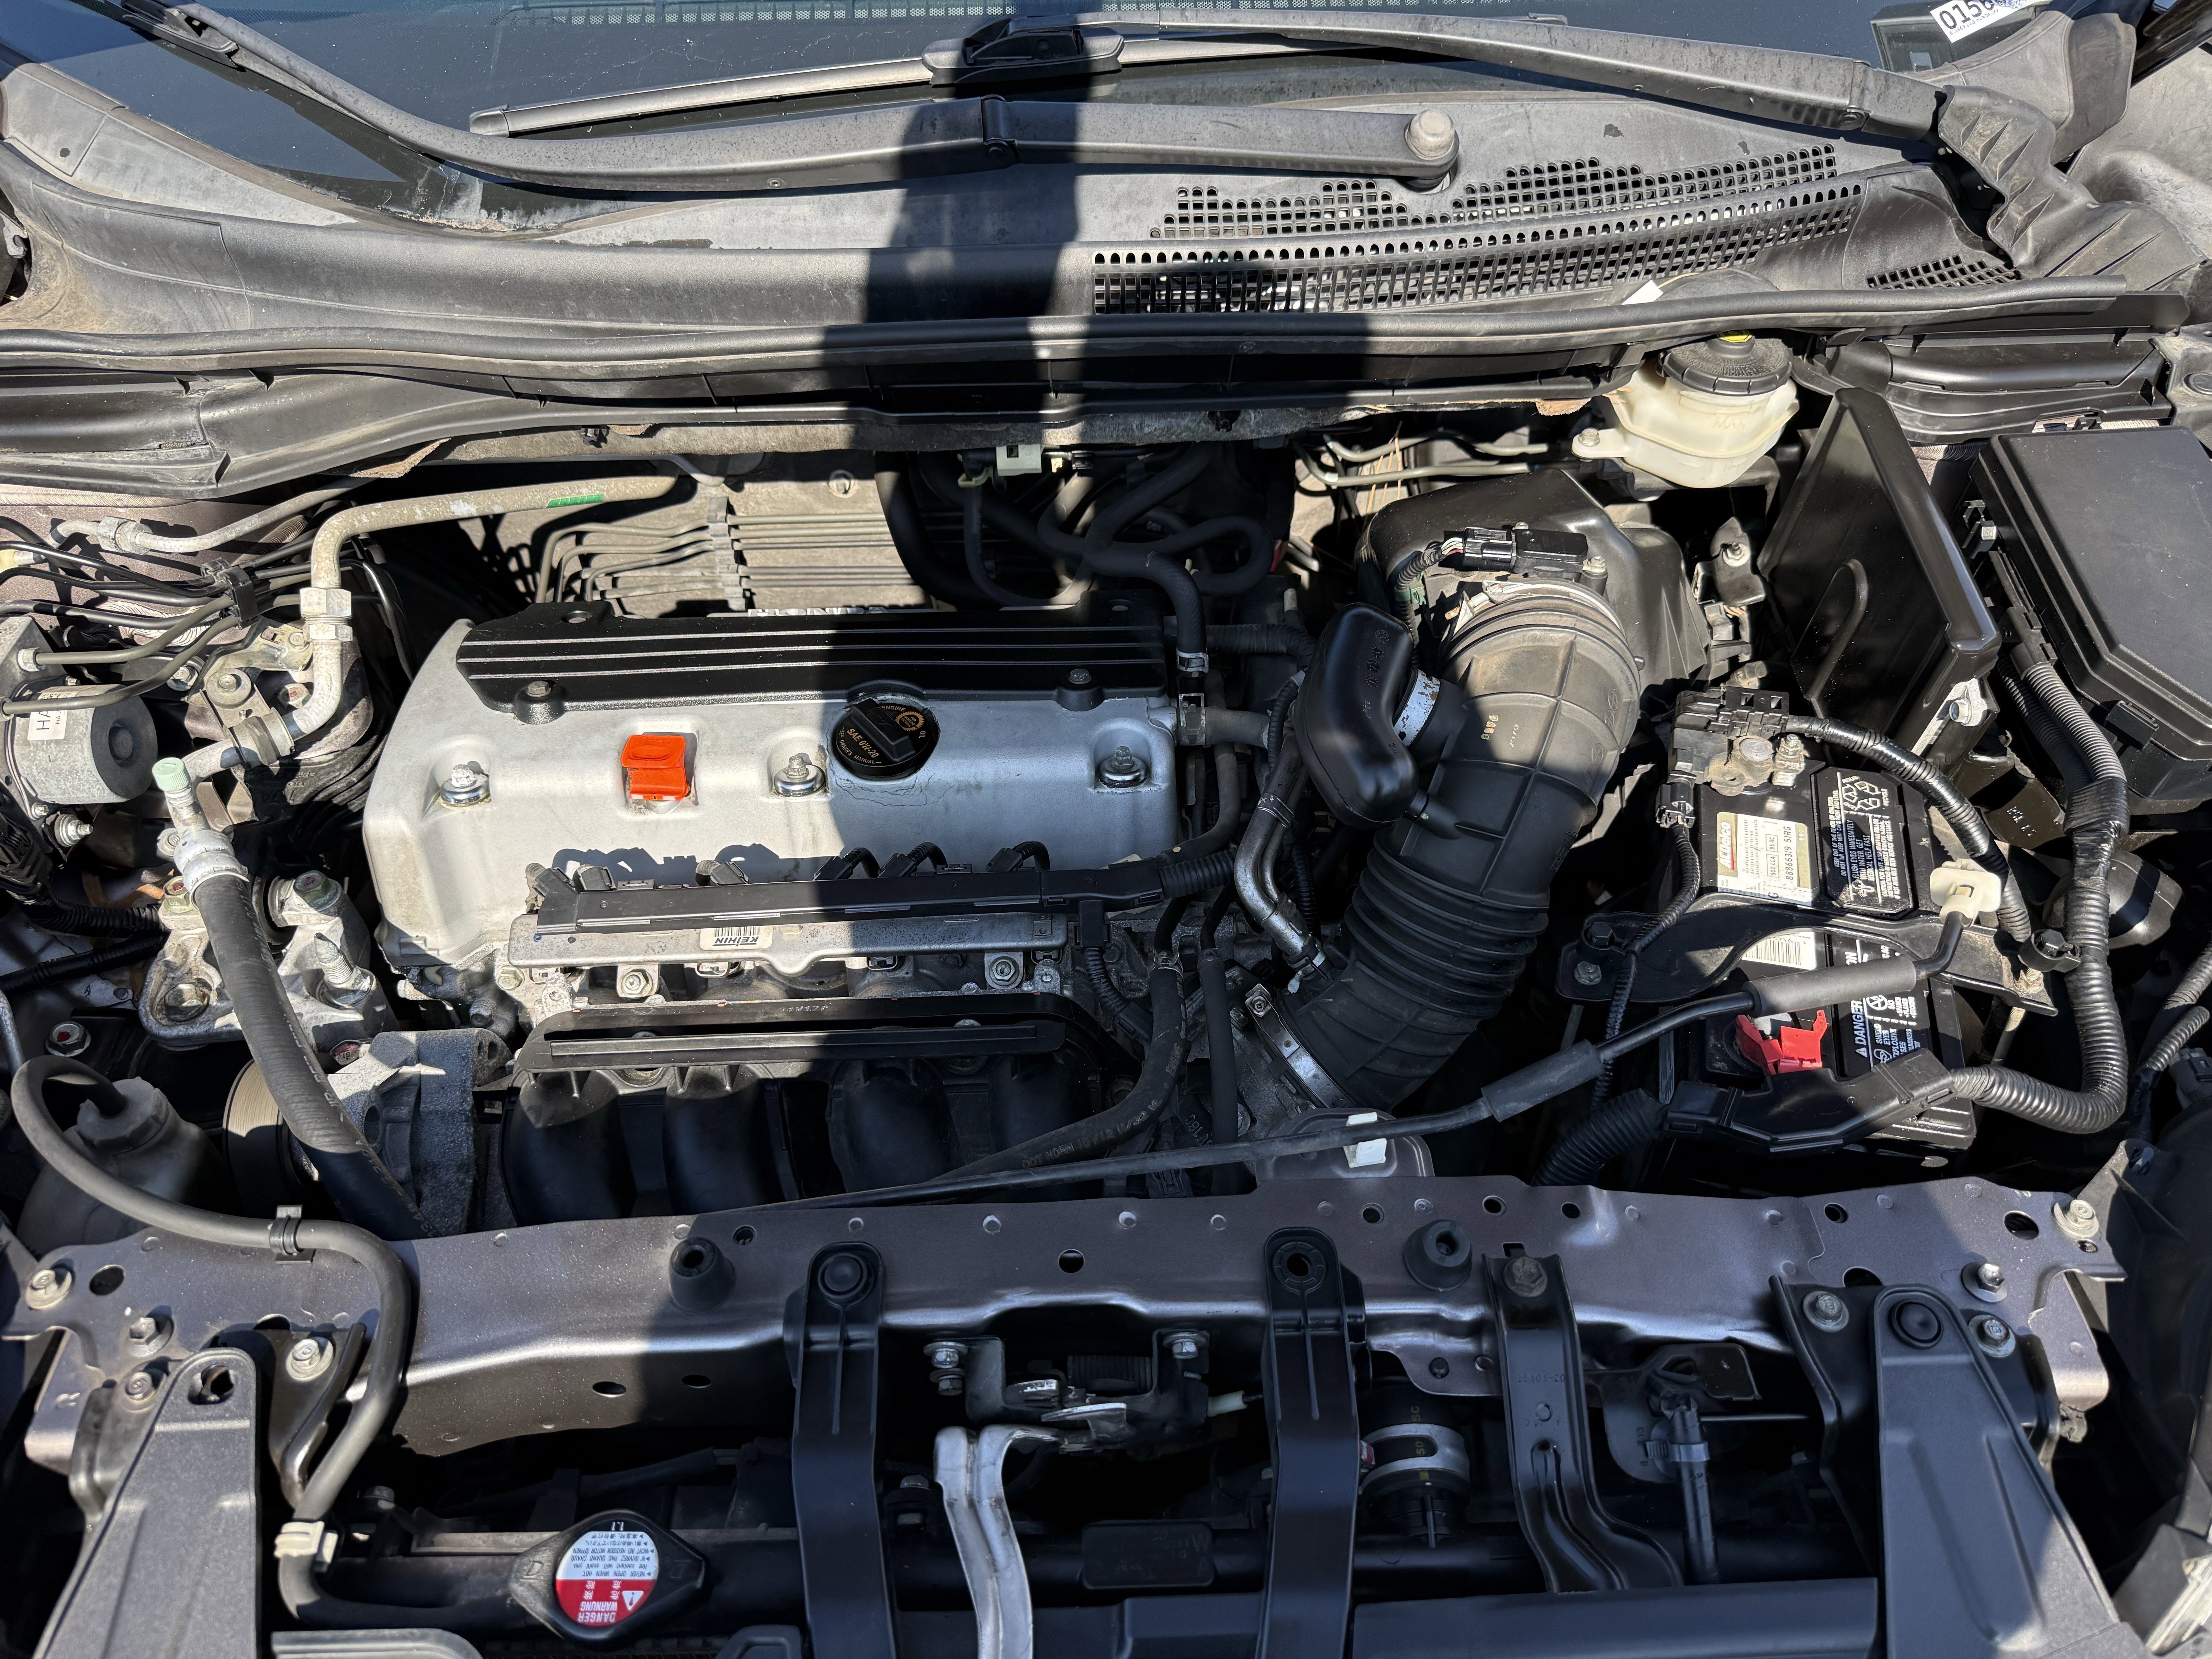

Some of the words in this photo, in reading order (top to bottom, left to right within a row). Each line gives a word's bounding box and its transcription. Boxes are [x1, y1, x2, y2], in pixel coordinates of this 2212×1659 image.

[839, 740, 853, 756] OWNER'S
[847, 728, 863, 742] SAE
[859, 740, 879, 758] 0W-20
[1847, 820, 1856, 849] IMMEDIATELY
[1719, 821, 1731, 868] ACDelco
[1784, 846, 1793, 880] 88866319
[1866, 861, 1874, 880] MEDICAL
[1859, 868, 1867, 879] WITH
[1885, 871, 1894, 897] INSTRUCTIONS
[713, 936, 759, 946] KEIHIN
[1887, 1000, 1896, 1009] NO
[1851, 1000, 1866, 1045] DANGER
[1874, 1023, 1882, 1044] SHIELD
[1882, 1030, 1891, 1045] EYES
[580, 1601, 617, 1611] WARNUNG
[577, 1612, 616, 1623] DANGER
